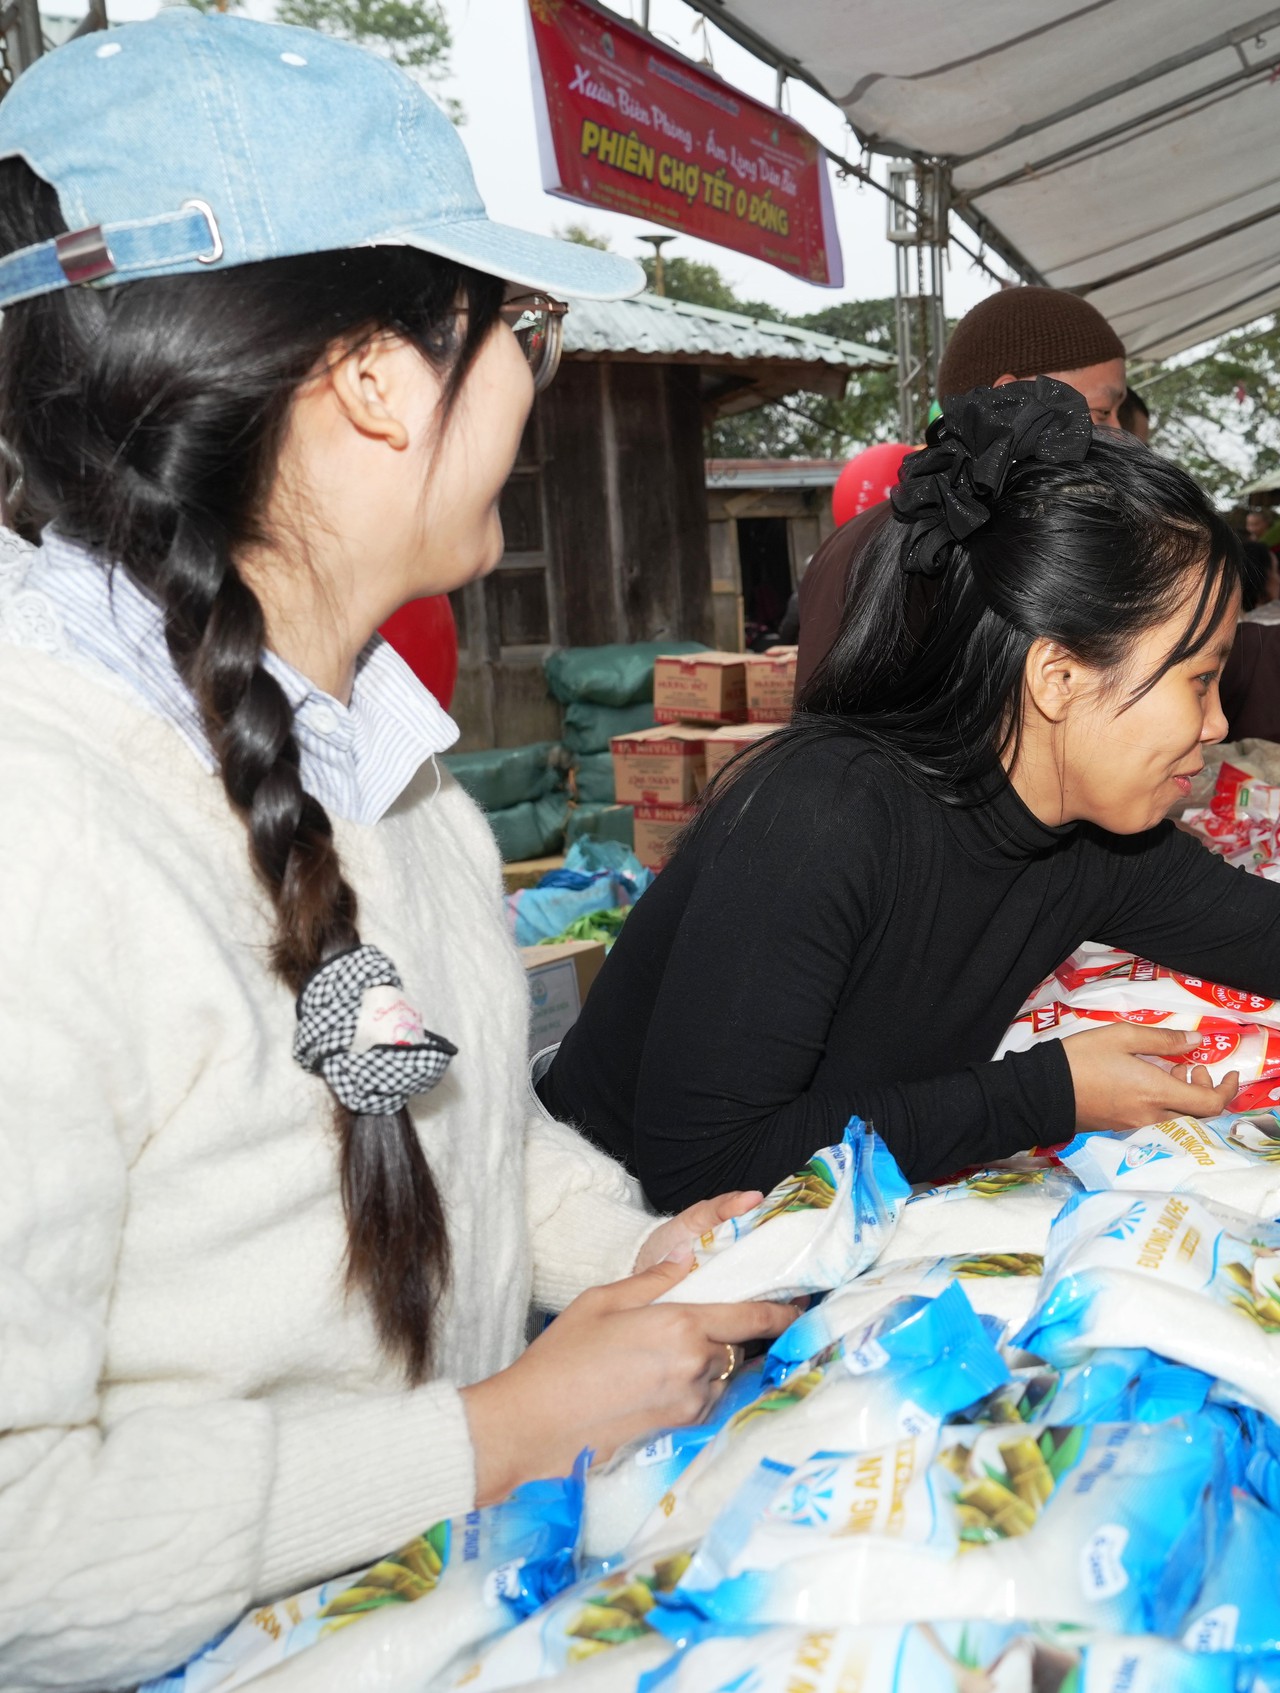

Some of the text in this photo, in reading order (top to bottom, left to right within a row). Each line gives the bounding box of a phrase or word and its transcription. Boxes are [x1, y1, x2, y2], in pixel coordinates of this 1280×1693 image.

[581, 118, 656, 182] PHIÊN
[658, 152, 699, 206] CHỢ
[702, 166, 735, 214] TẾT
